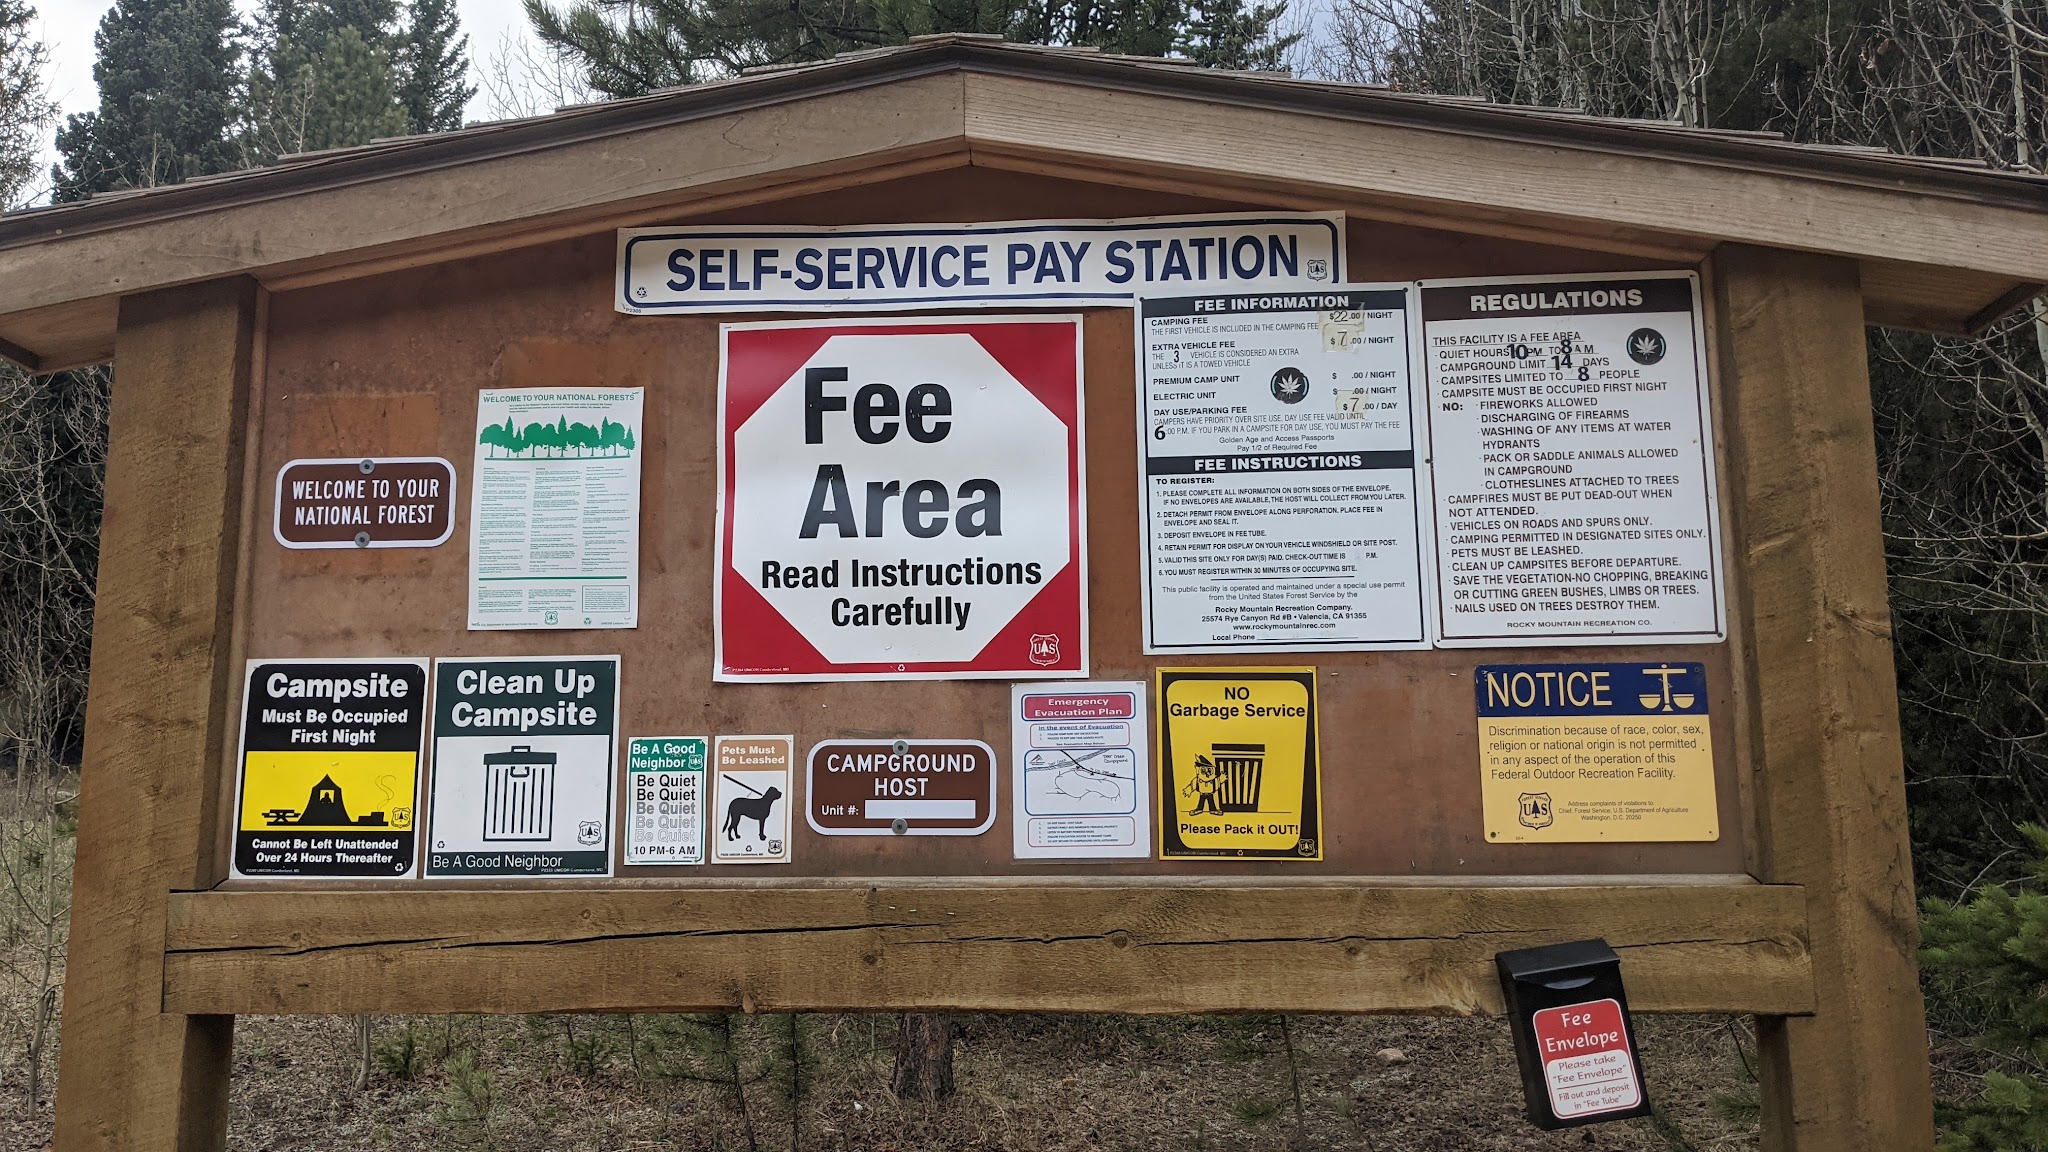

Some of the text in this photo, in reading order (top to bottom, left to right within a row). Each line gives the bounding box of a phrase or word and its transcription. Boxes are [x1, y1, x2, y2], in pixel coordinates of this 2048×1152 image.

[666, 234, 1298, 293] SELF-SERVICE PAY STATION
[1194, 295, 1349, 312] FEE INFORMATION
[1470, 289, 1643, 311] REGULATIONS
[1151, 318, 1190, 326] CAMPING
[1152, 340, 1236, 351] EXTRA VEHICLE FEE
[1433, 331, 1581, 346] THIS FACILITY IS A FEE AREA
[1441, 381, 1668, 398] CAMPSITE MUST BE OCCUPIED FIRST NIGHT
[805, 366, 952, 444] Fee
[1194, 455, 1362, 471] FEE INSTRUCTIONS
[293, 478, 439, 500] WELCOME TO YOUR
[798, 464, 1002, 539] Area
[295, 504, 434, 525] NATIONAL FOREST
[1451, 545, 1583, 558] PETS MUST BE LEASHED.
[761, 557, 1042, 588] Read Instructions
[831, 597, 971, 631] Carefully
[1233, 621, 1336, 630] www.rockymountainrec.com
[266, 672, 409, 703] Campsite
[456, 668, 595, 698] Clean Up
[1487, 671, 1612, 708] NOTICE
[1224, 687, 1250, 700] NO
[1048, 698, 1109, 706] Emergency
[262, 709, 408, 725] Must Be Occupied
[452, 701, 597, 732] Campsite
[1035, 709, 1095, 717] Evacuation
[1170, 703, 1305, 720] Garbage Service
[291, 729, 376, 746] First Night
[1489, 725, 1704, 736] Discrimination because of race, color, sex,
[633, 743, 696, 754] Be A Good
[722, 746, 775, 754] Pets Must
[1490, 739, 1697, 752] religion or national origin is not permitted
[632, 757, 686, 770] Neighbor
[740, 756, 785, 764] Leashed
[827, 754, 976, 772] CAMPGROUND
[1490, 754, 1676, 767] in any aspect of the operation of this
[1491, 767, 1676, 779] Federal Outdoor Recreation Facility.
[637, 774, 696, 787] Be Quiet
[874, 778, 928, 796] HOST
[637, 788, 696, 801] Be Quiet
[636, 802, 696, 815] Be Quiet
[821, 805, 859, 815] Unit #:
[636, 815, 695, 829] Be Quiet
[635, 829, 695, 843] Be Quiet
[1180, 824, 1299, 835] Please Pack it OUT!
[252, 839, 399, 850] Cannot Be Left Unattended
[634, 846, 695, 855] 10 PM-6 AM
[256, 853, 393, 864] Over 24 Hours Thereafter
[433, 856, 450, 868] Be
[453, 856, 462, 867] A
[465, 855, 500, 868] Good
[505, 855, 563, 870] Neighbor
[1561, 1013, 1591, 1028] Fee
[1546, 1031, 1619, 1053] Envelope
[1558, 1055, 1616, 1071] Please take
[1559, 1083, 1629, 1101] Fill out and deposit
[1574, 1102, 1582, 1110] in
